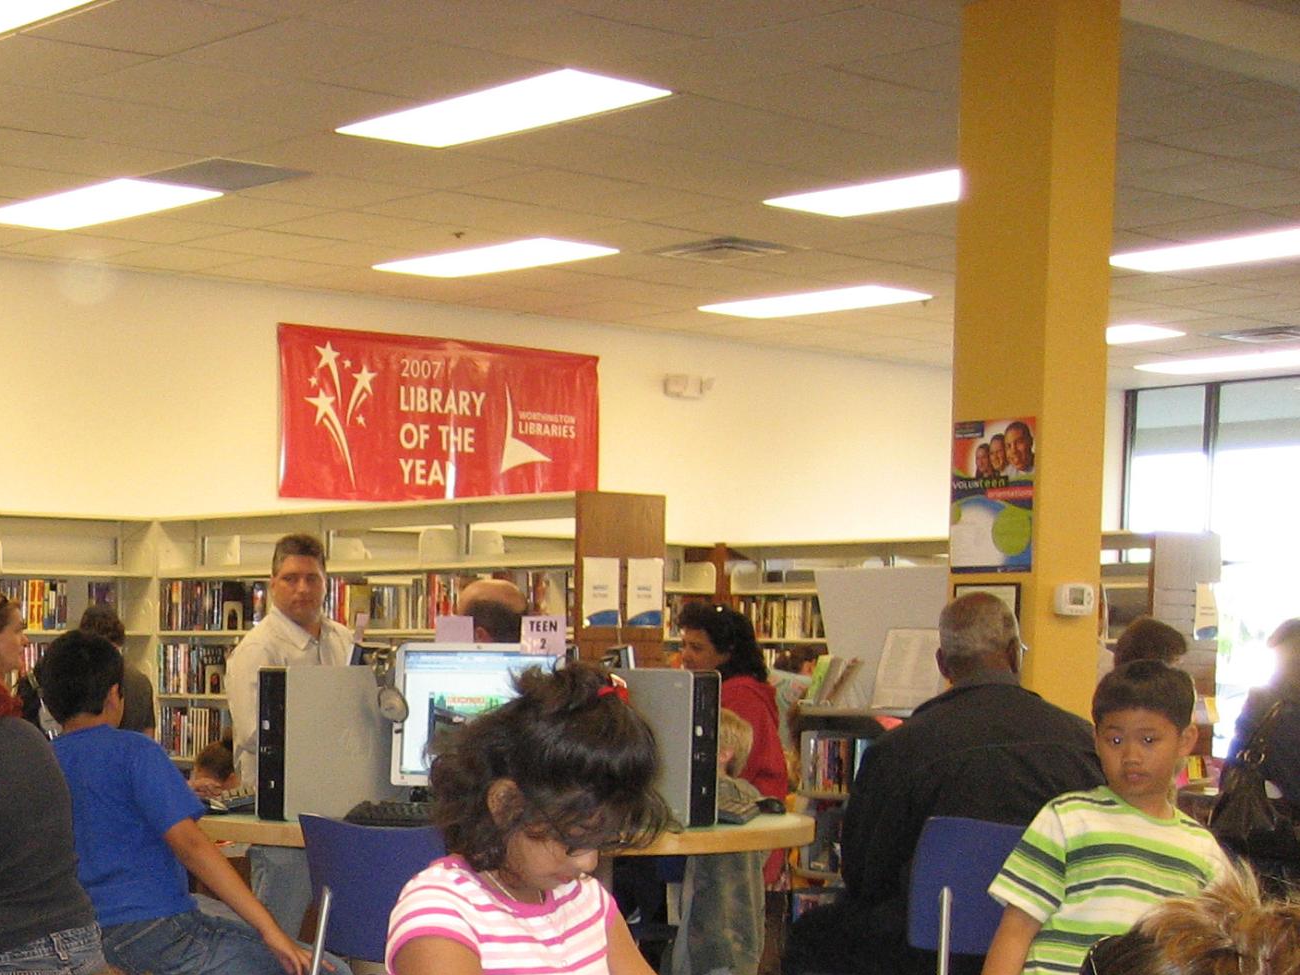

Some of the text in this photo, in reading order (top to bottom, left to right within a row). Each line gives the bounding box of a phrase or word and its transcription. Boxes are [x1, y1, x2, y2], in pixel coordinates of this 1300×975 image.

[400, 358, 442, 379] 2007
[399, 385, 486, 417] LIBRARY
[518, 411, 576, 424] WORTHINGTON
[399, 423, 476, 453] OF THE
[518, 423, 576, 439] LIBRARIES
[529, 620, 558, 633] TEEN
[540, 638, 547, 650] 2
